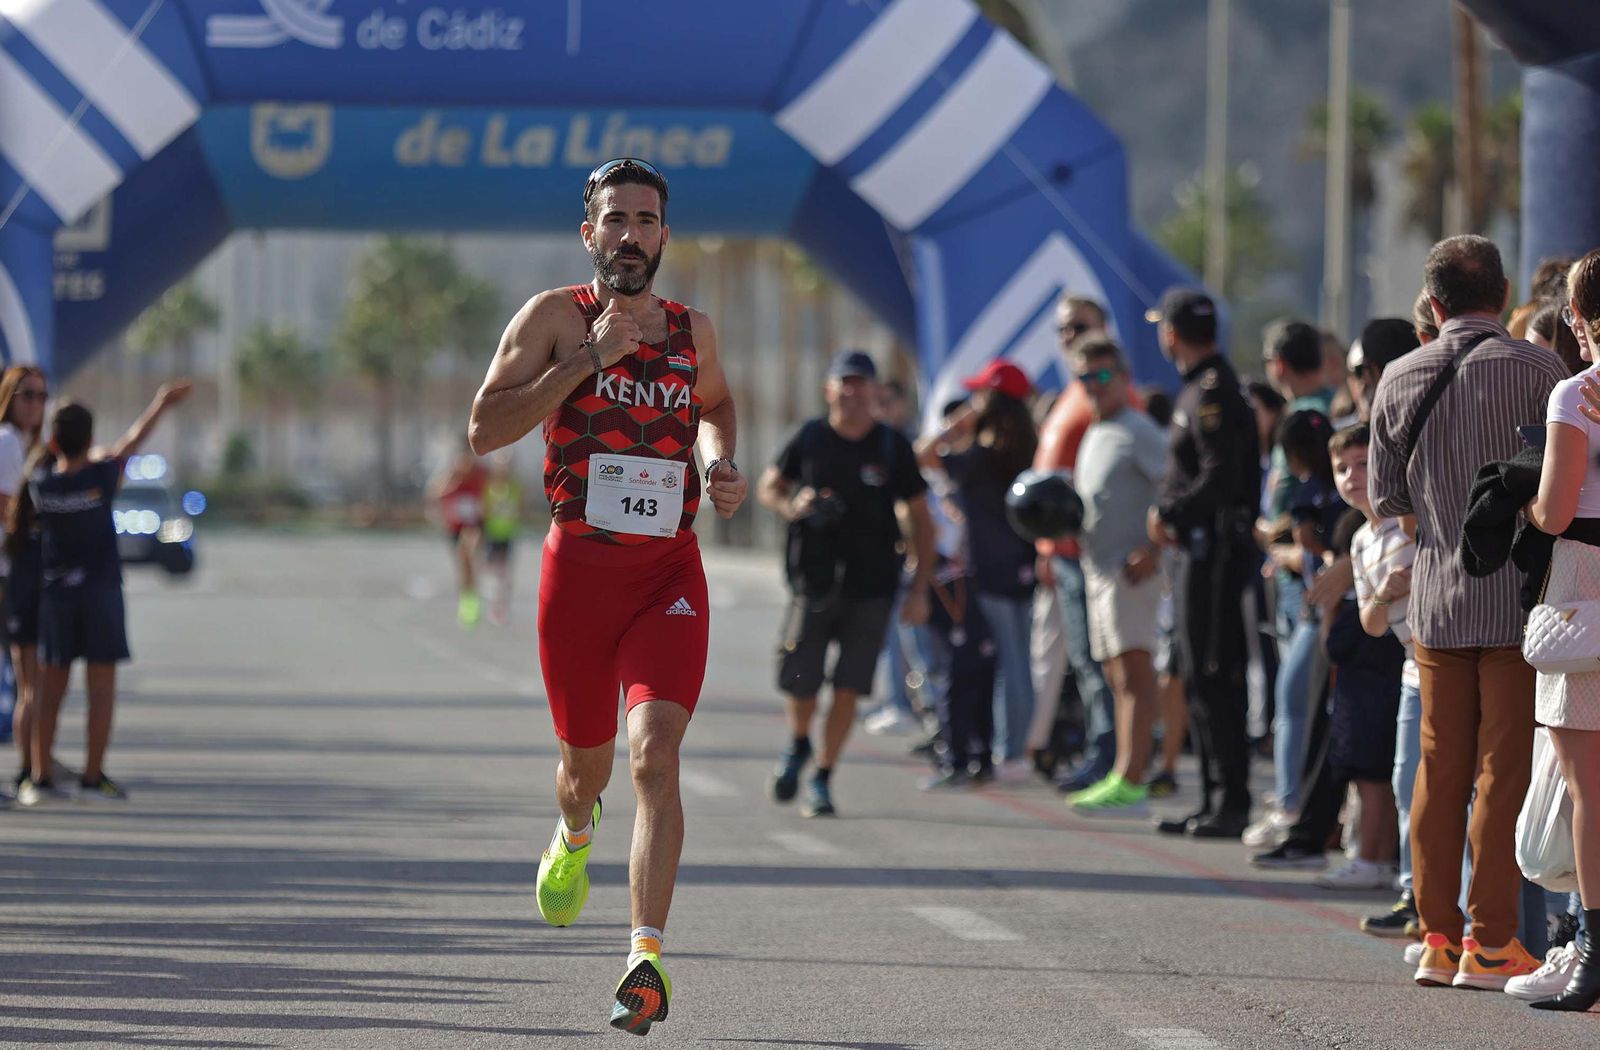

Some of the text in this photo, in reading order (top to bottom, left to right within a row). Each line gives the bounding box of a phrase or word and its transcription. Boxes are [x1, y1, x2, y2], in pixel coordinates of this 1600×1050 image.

[356, 6, 525, 51] de Cádiz
[394, 110, 733, 168] de La Línea
[595, 372, 691, 409] KENYA
[628, 477, 658, 487] Santander
[620, 497, 658, 517] 143
[665, 608, 697, 617] adidas
